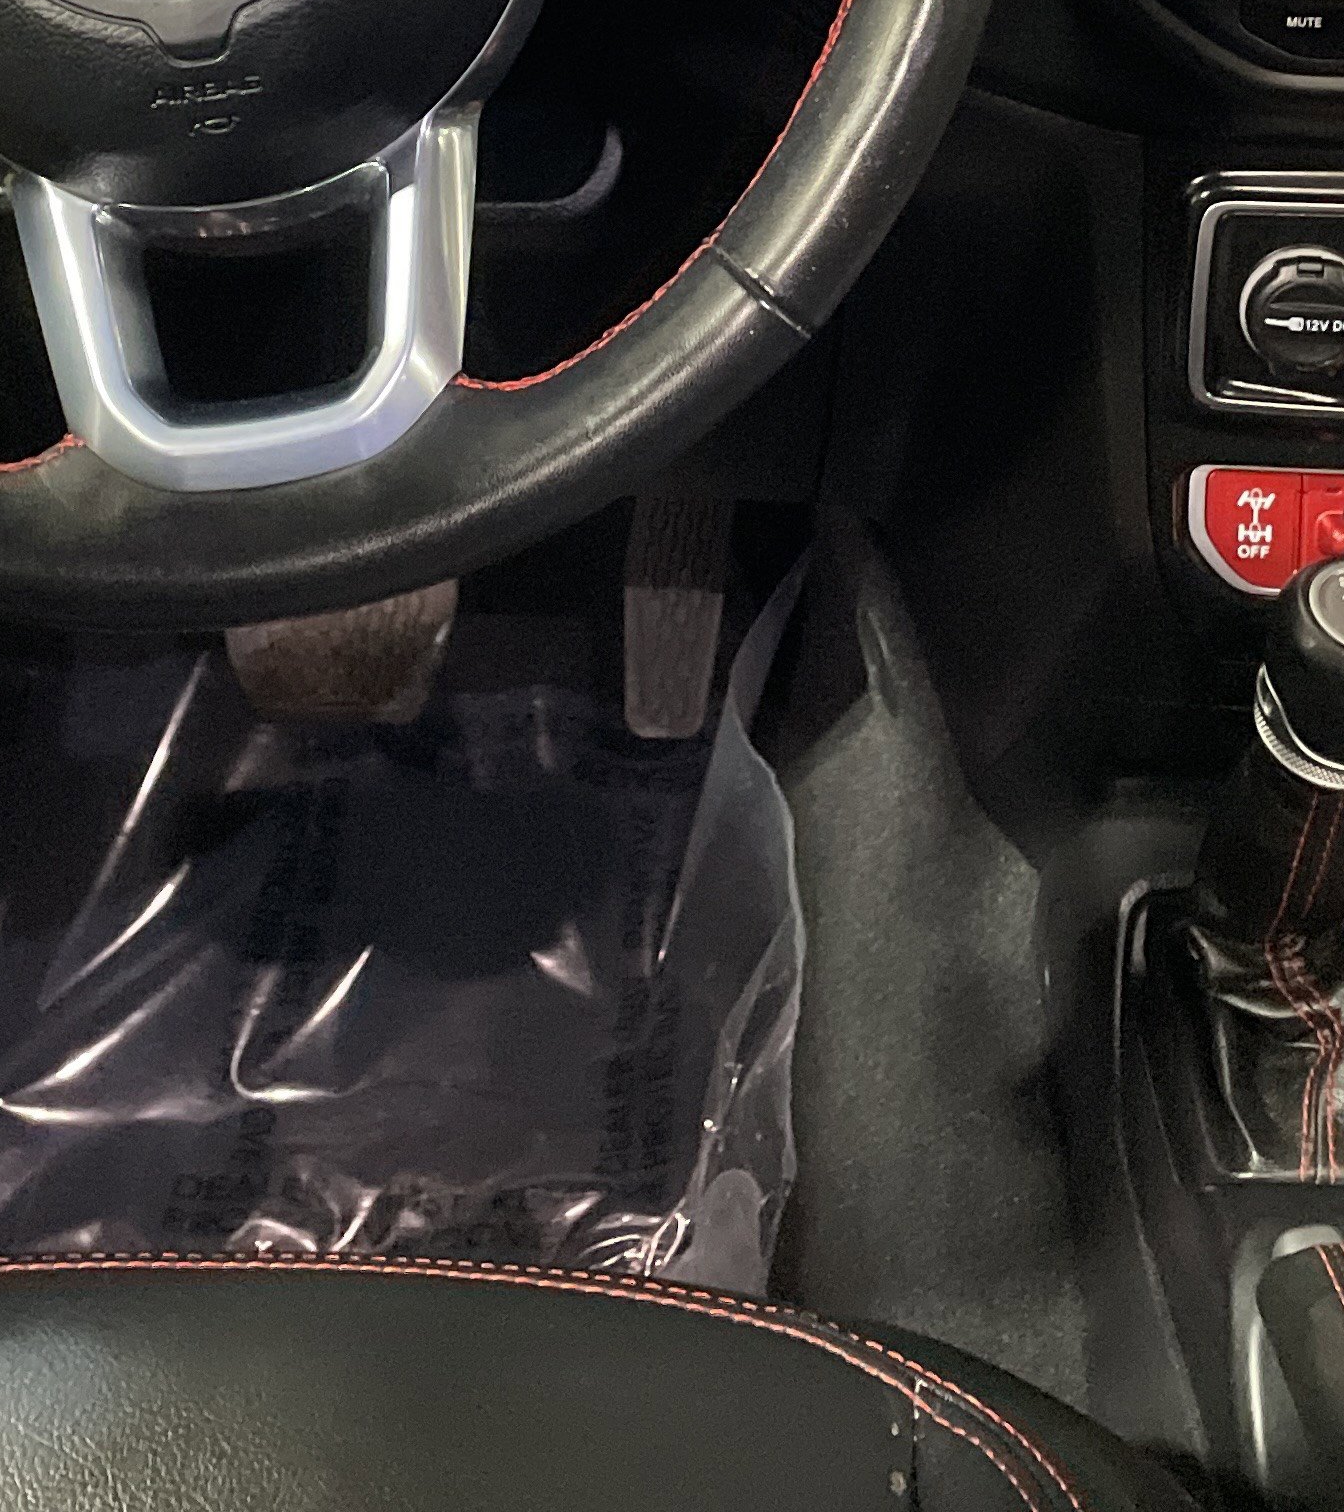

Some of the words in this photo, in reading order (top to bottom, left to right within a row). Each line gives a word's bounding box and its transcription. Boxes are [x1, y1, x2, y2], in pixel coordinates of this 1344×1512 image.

[1286, 16, 1322, 28] MUTE
[1305, 319, 1329, 333] 12V
[1237, 545, 1270, 559] OFF
